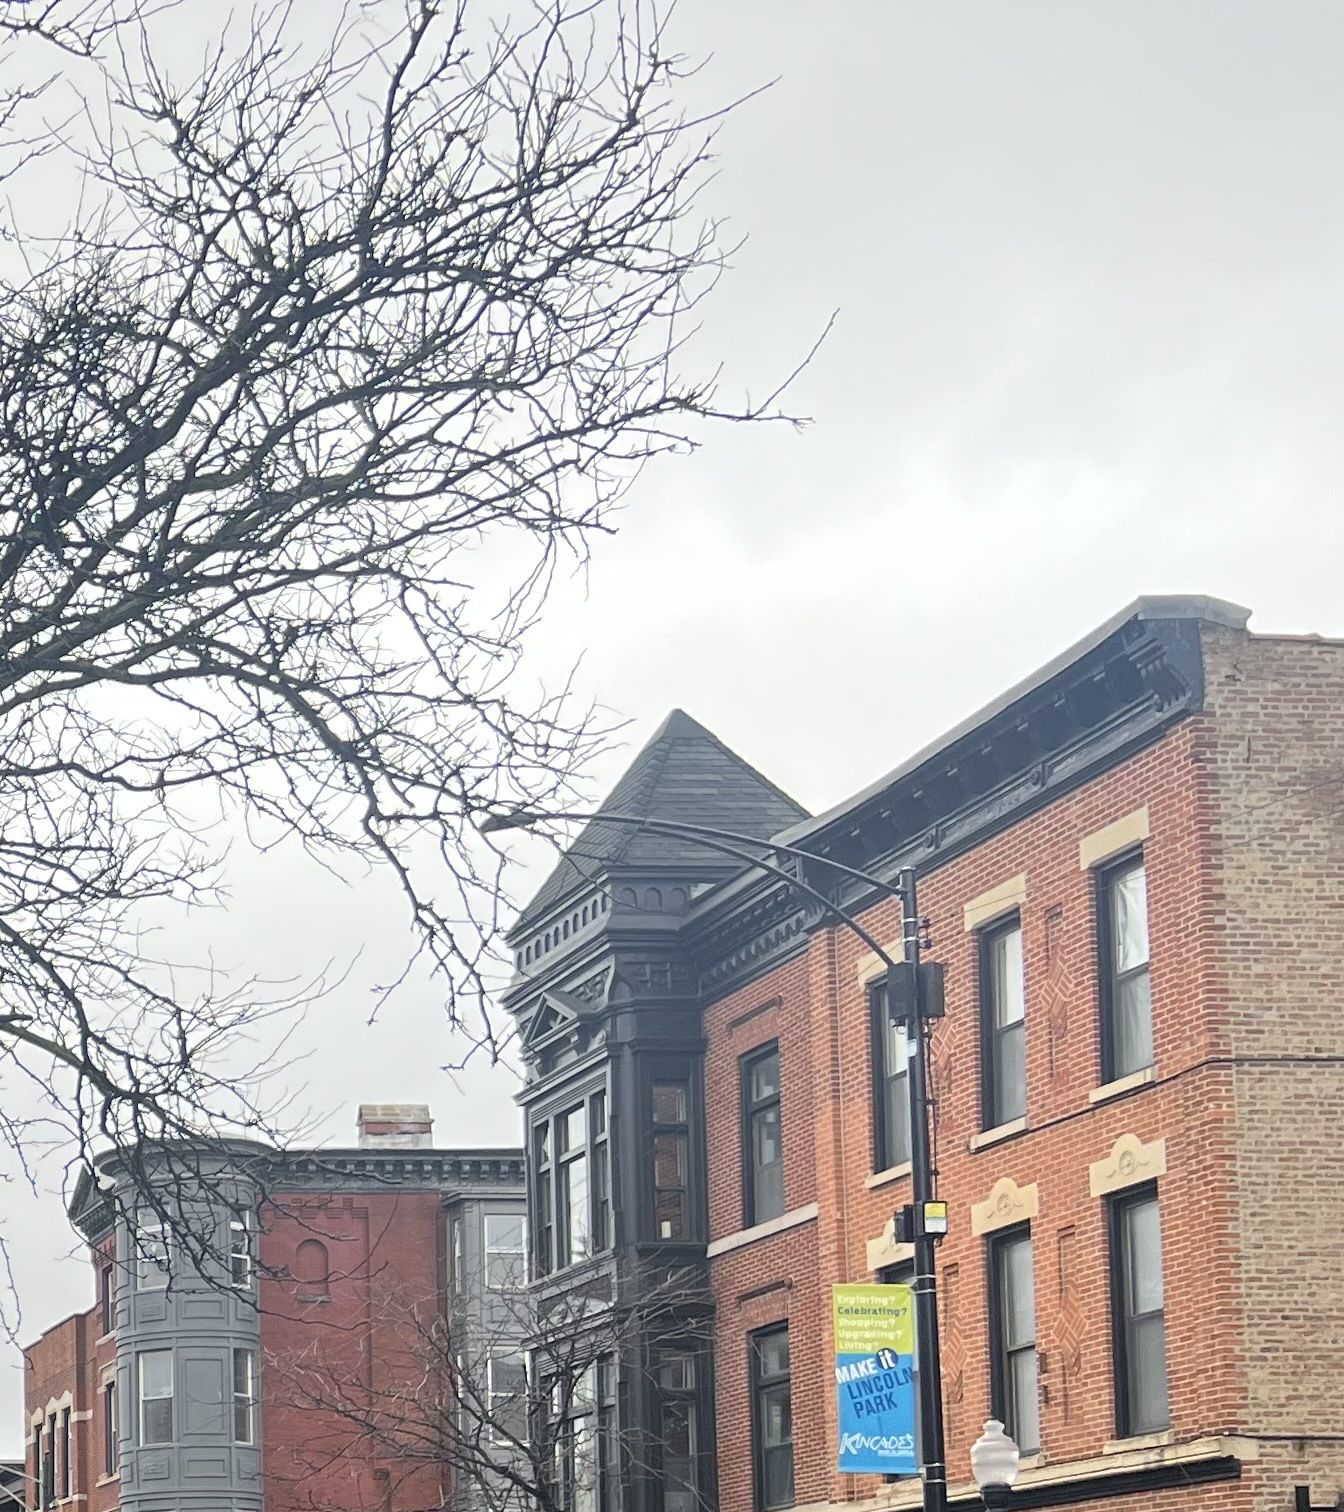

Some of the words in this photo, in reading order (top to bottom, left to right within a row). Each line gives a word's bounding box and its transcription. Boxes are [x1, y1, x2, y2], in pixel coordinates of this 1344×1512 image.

[837, 1295, 896, 1306] Exploring?
[837, 1307, 907, 1317] Celebrating?
[838, 1318, 896, 1329] Shopping?
[838, 1330, 902, 1340] Upgrading?
[838, 1341, 879, 1352] Living?
[835, 1358, 879, 1384] MAKE
[878, 1349, 895, 1370] it
[847, 1366, 914, 1400] LINCOLN
[853, 1391, 898, 1419] PARK
